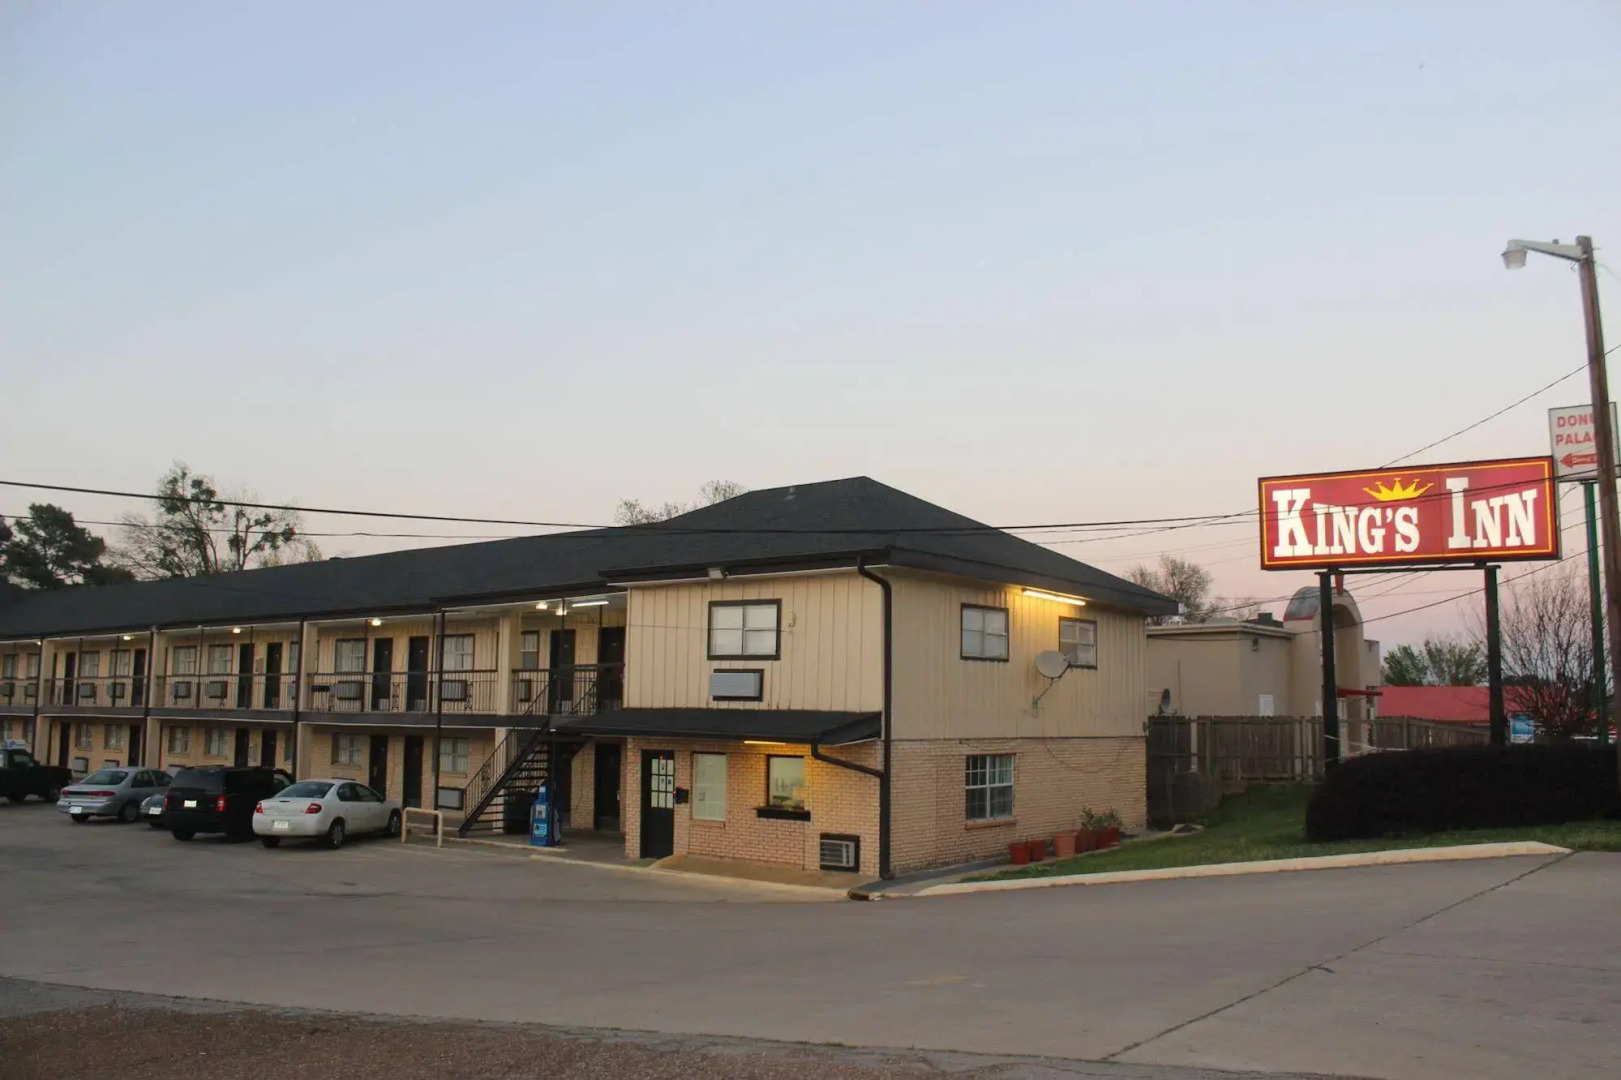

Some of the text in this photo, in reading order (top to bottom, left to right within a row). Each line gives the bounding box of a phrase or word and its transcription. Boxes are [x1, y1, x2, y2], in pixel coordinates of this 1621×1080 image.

[1555, 431, 1594, 446] PALA
[1272, 477, 1538, 558] KING'S INN
